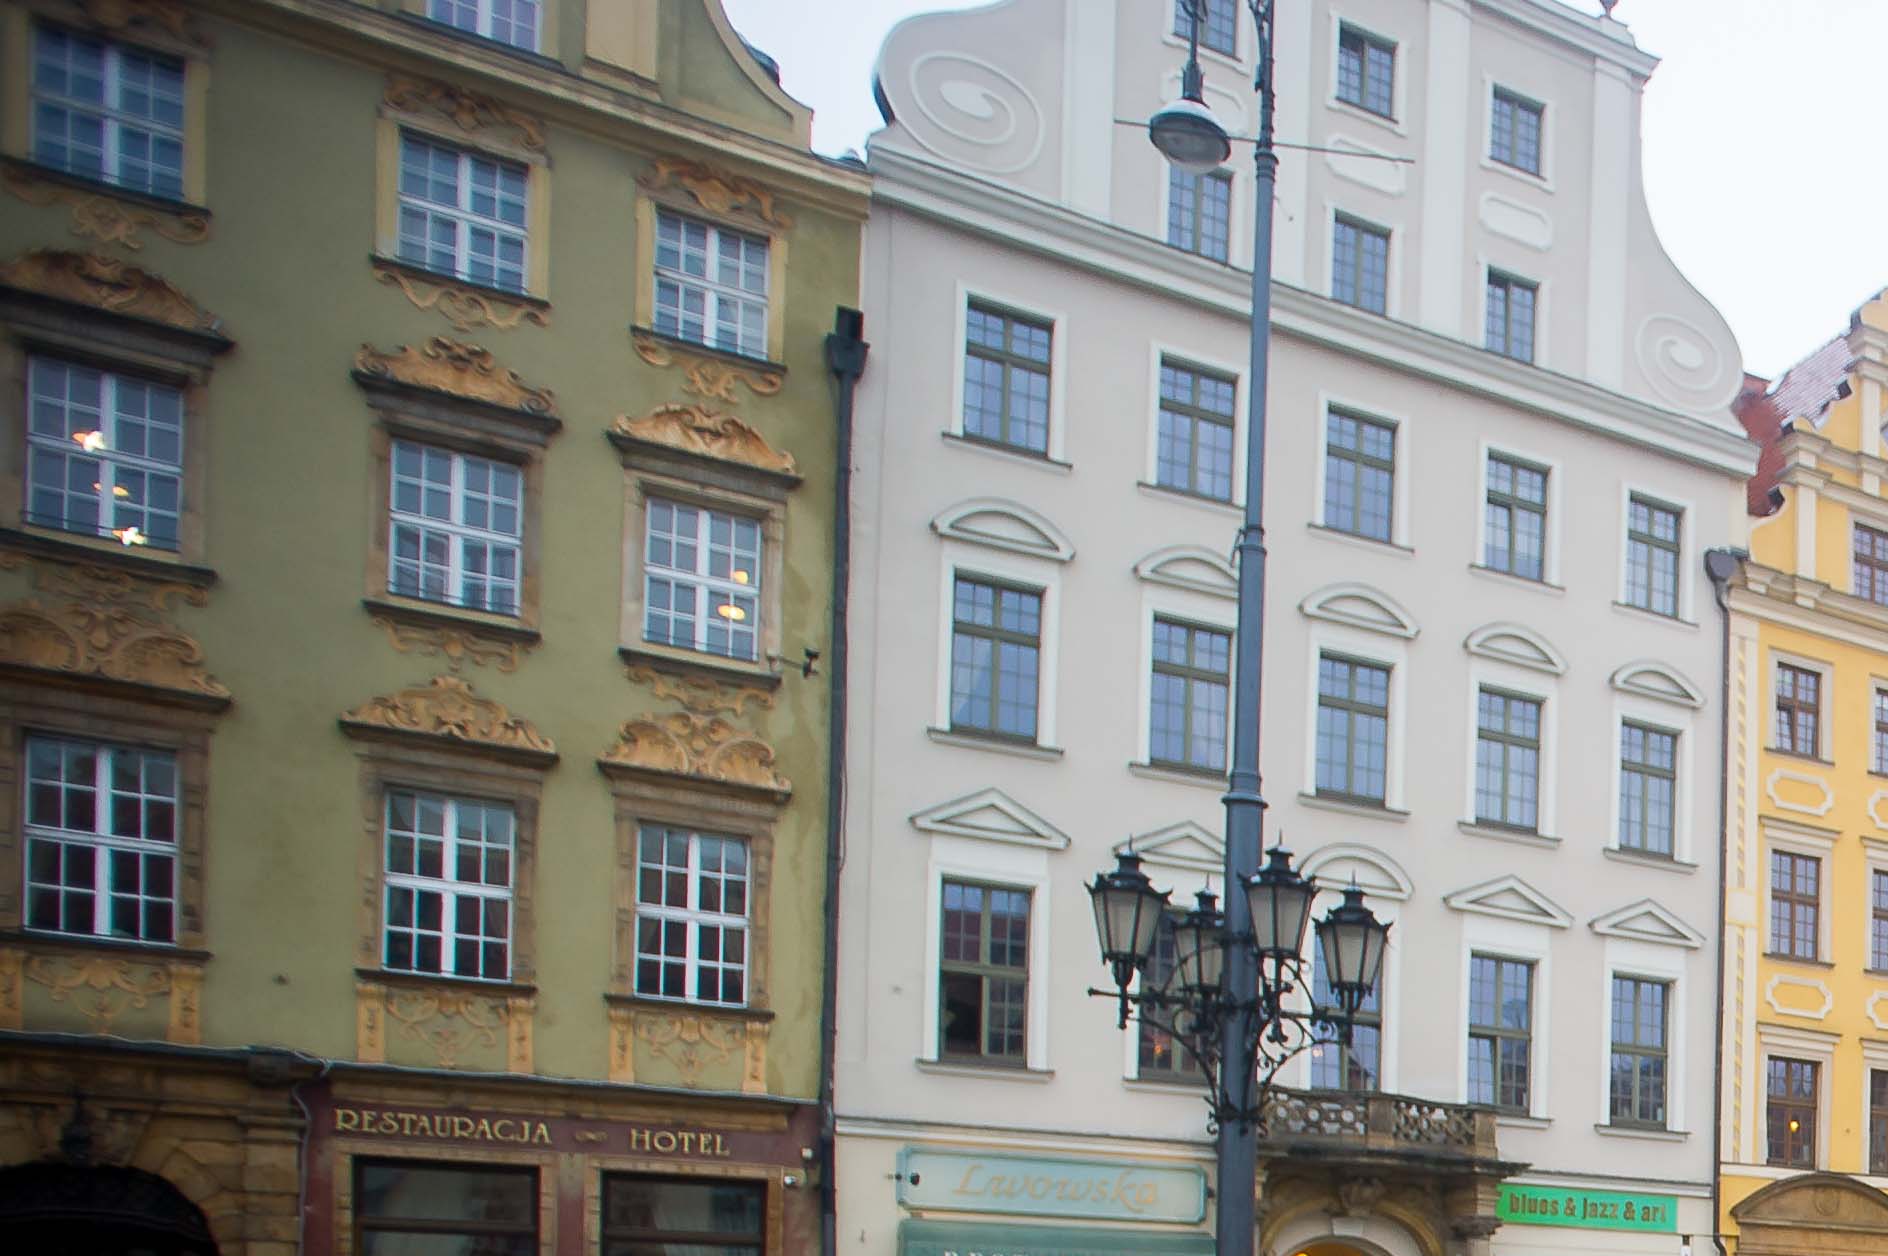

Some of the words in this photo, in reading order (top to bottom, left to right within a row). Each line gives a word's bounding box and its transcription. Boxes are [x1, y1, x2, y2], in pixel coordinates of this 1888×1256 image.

[334, 1108, 553, 1146] RESTAURACJA
[629, 1127, 732, 1157] HOTEL
[953, 1164, 1159, 1214] Lwowska
[1509, 1192, 1559, 1217] blues
[1563, 1197, 1576, 1217] &
[1623, 1201, 1636, 1221] &
